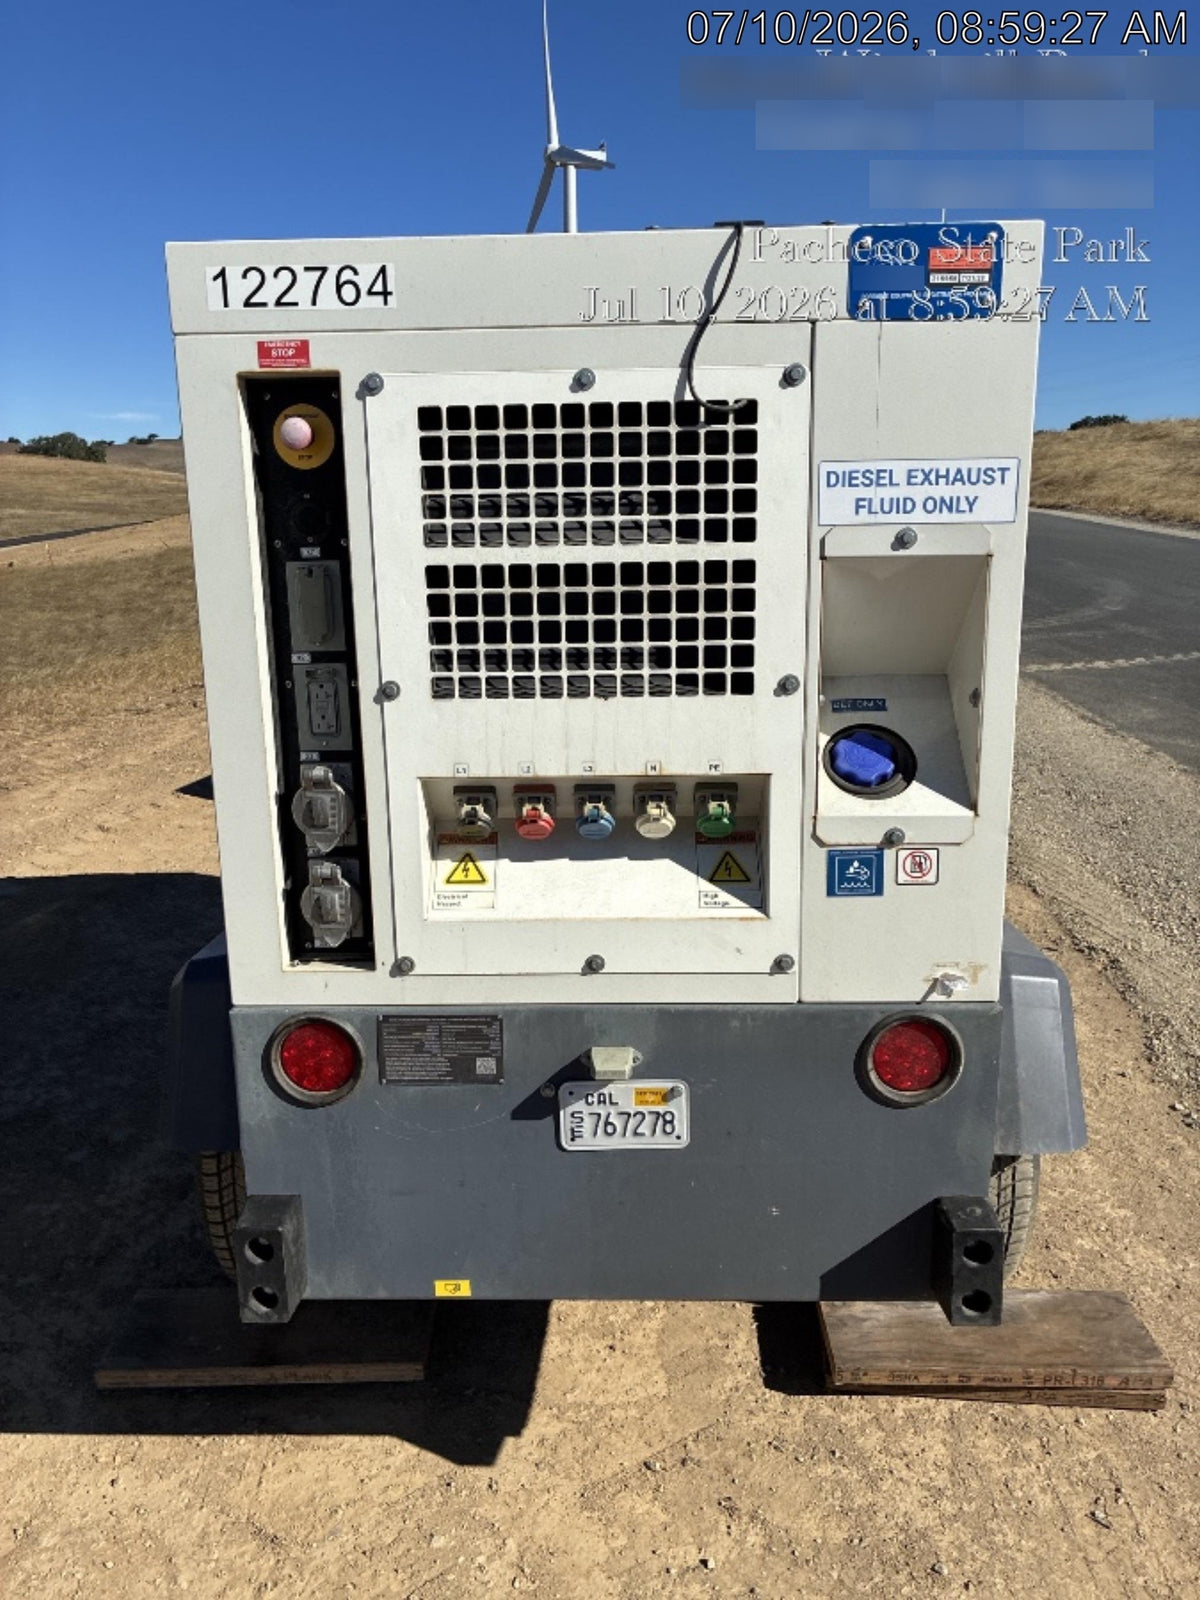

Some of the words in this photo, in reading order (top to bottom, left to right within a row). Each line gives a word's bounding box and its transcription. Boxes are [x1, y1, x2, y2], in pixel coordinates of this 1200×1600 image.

[212, 264, 394, 309] 122764
[271, 347, 296, 358] STOP
[826, 468, 900, 489] DIESEL
[906, 466, 1011, 487] EXHAUST
[854, 496, 917, 516] FLUID
[922, 495, 979, 515] ONLY
[584, 1092, 619, 1107] CAL
[588, 1110, 676, 1138] 767278
